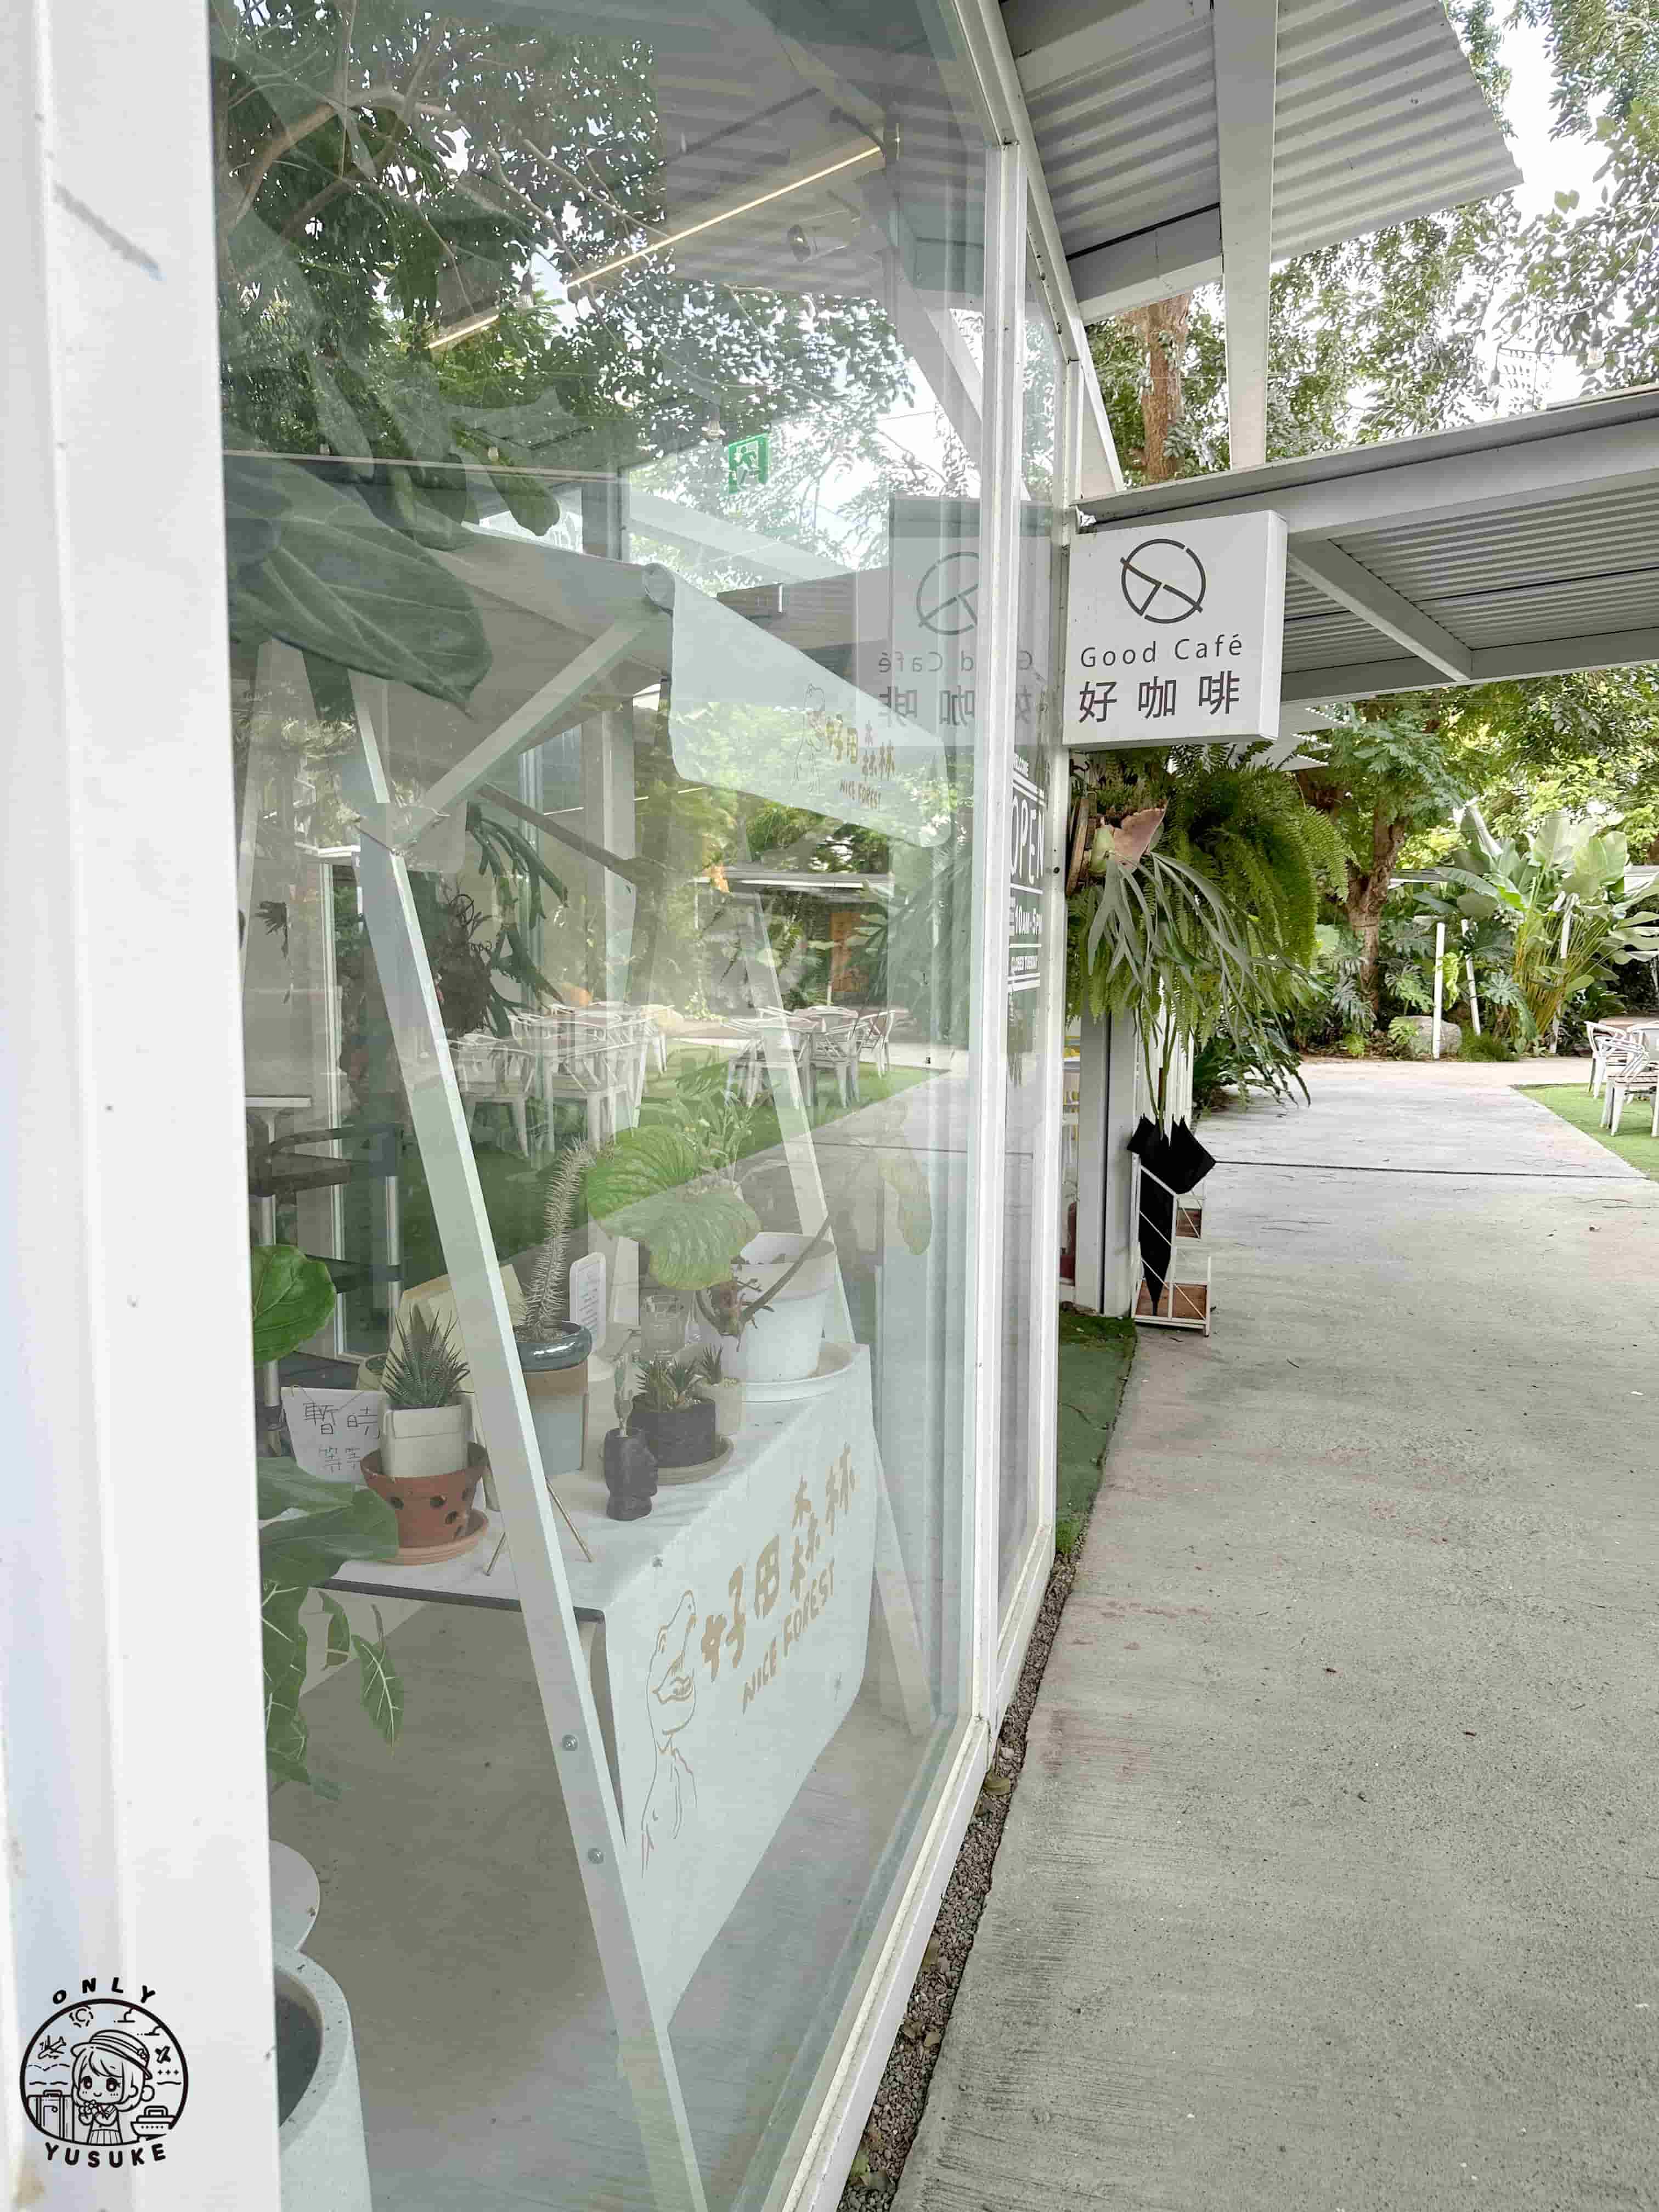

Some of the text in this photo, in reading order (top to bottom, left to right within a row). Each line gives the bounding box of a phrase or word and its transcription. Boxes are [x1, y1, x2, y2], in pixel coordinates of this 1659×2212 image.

[1081, 634, 1243, 668] Good Café
[1079, 670, 1240, 723] 好咖啡
[1010, 795, 1045, 884] OPEN
[742, 1555, 835, 1716] NICE FOREST
